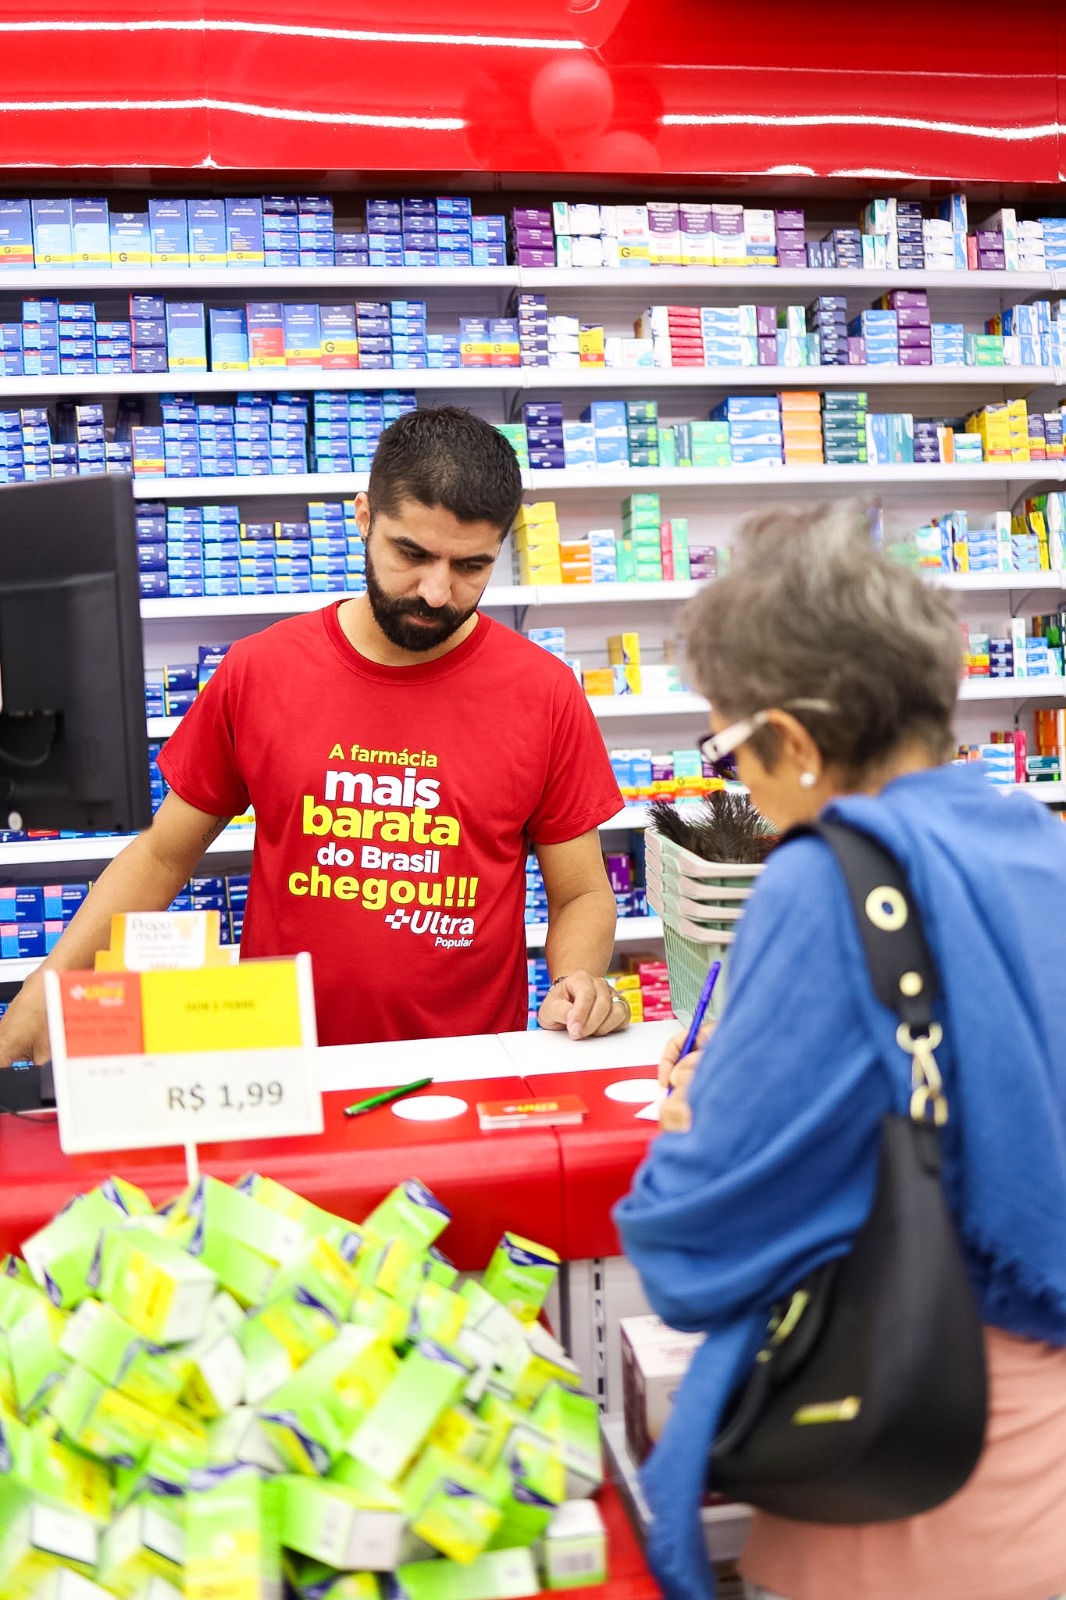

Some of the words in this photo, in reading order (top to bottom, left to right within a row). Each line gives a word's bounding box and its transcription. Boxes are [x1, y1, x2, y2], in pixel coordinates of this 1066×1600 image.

[118, 252, 128, 262] G
[621, 247, 631, 257] G
[324, 341, 335, 353] G
[329, 743, 345, 760] A
[351, 744, 439, 768] farmácia
[324, 767, 441, 810] mais
[302, 795, 461, 846] barata
[316, 842, 355, 866] do
[360, 845, 441, 874] Brasil
[288, 866, 479, 910] chegou!!!
[410, 909, 475, 935] Ultra
[434, 936, 473, 949] Popular
[167, 1081, 206, 1113] R$
[219, 1080, 284, 1112] 1,99
